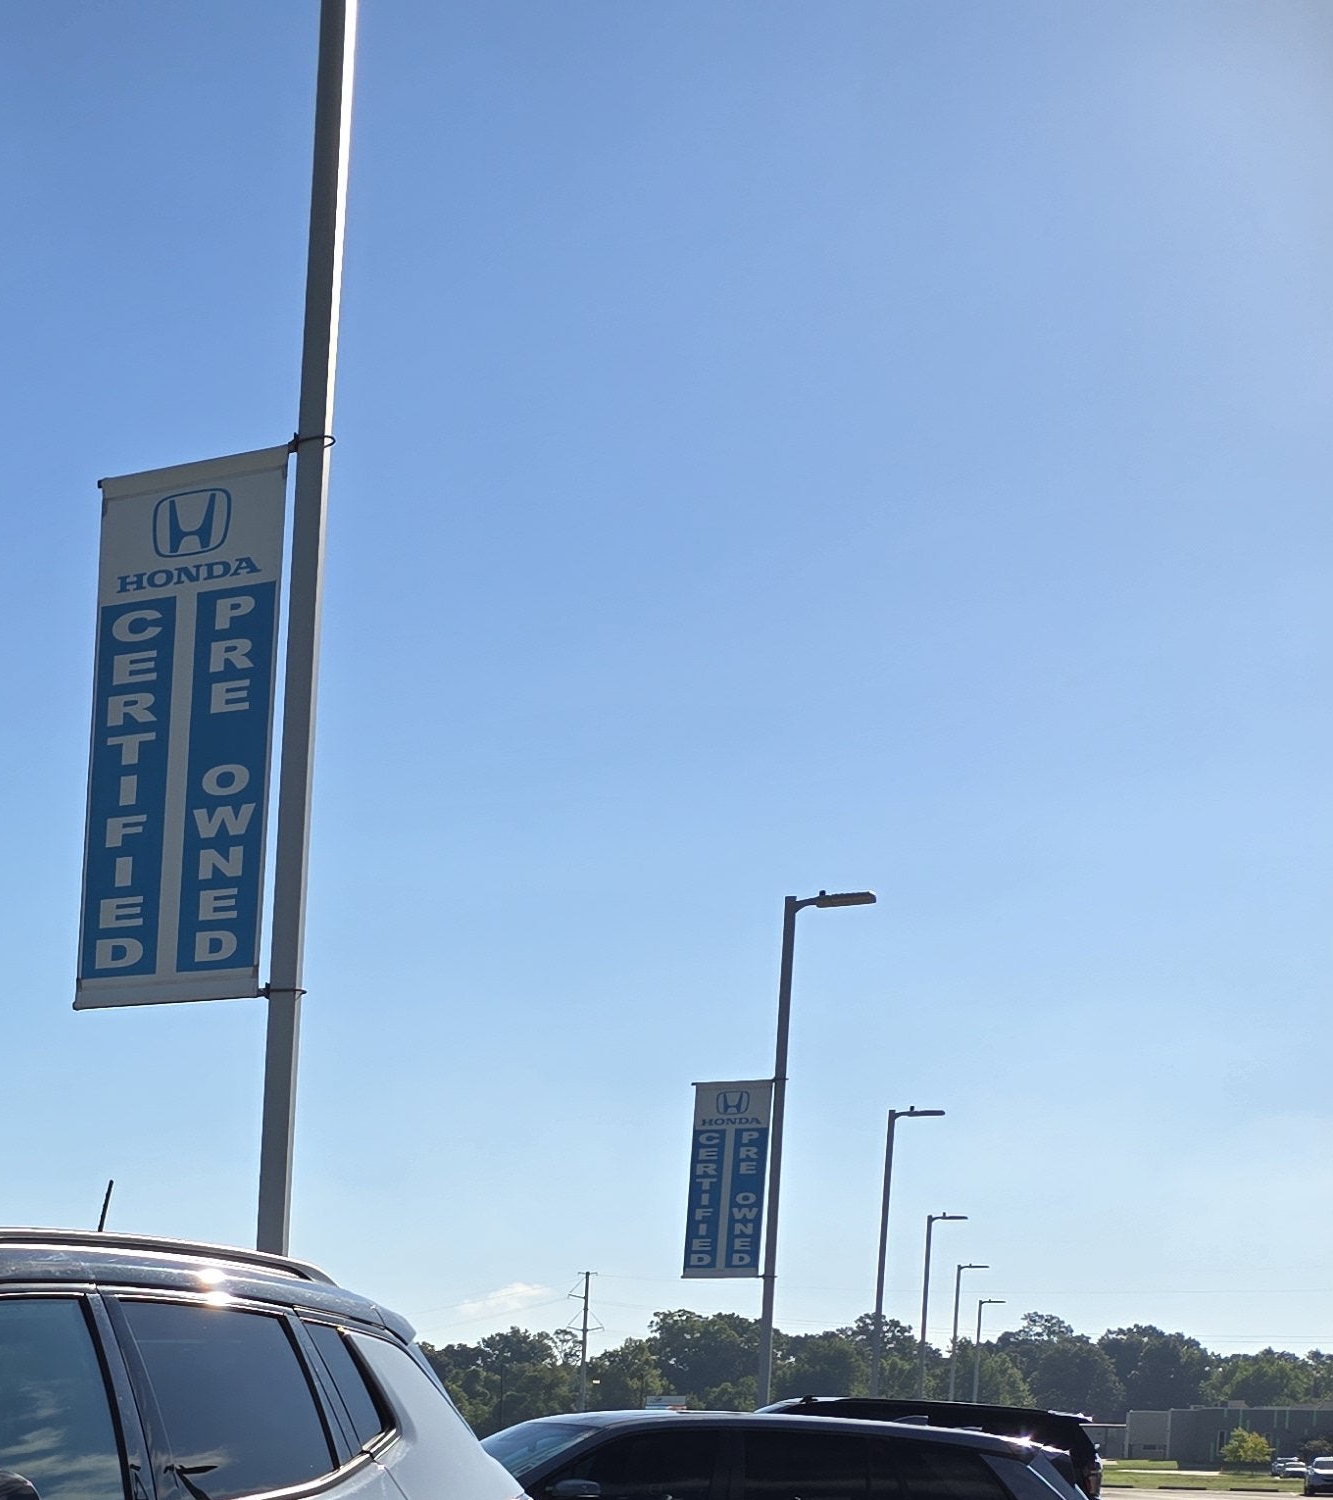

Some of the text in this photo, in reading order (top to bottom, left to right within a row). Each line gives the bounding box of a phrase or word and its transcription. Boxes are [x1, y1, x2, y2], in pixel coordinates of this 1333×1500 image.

[116, 556, 262, 593] HONDA
[94, 609, 164, 970] CERTIFIED
[193, 595, 256, 963] PRE OWNED
[701, 1116, 762, 1127] HONDA
[689, 1132, 720, 1266] CERTIFIED
[731, 1131, 759, 1266] PRE OWNED
